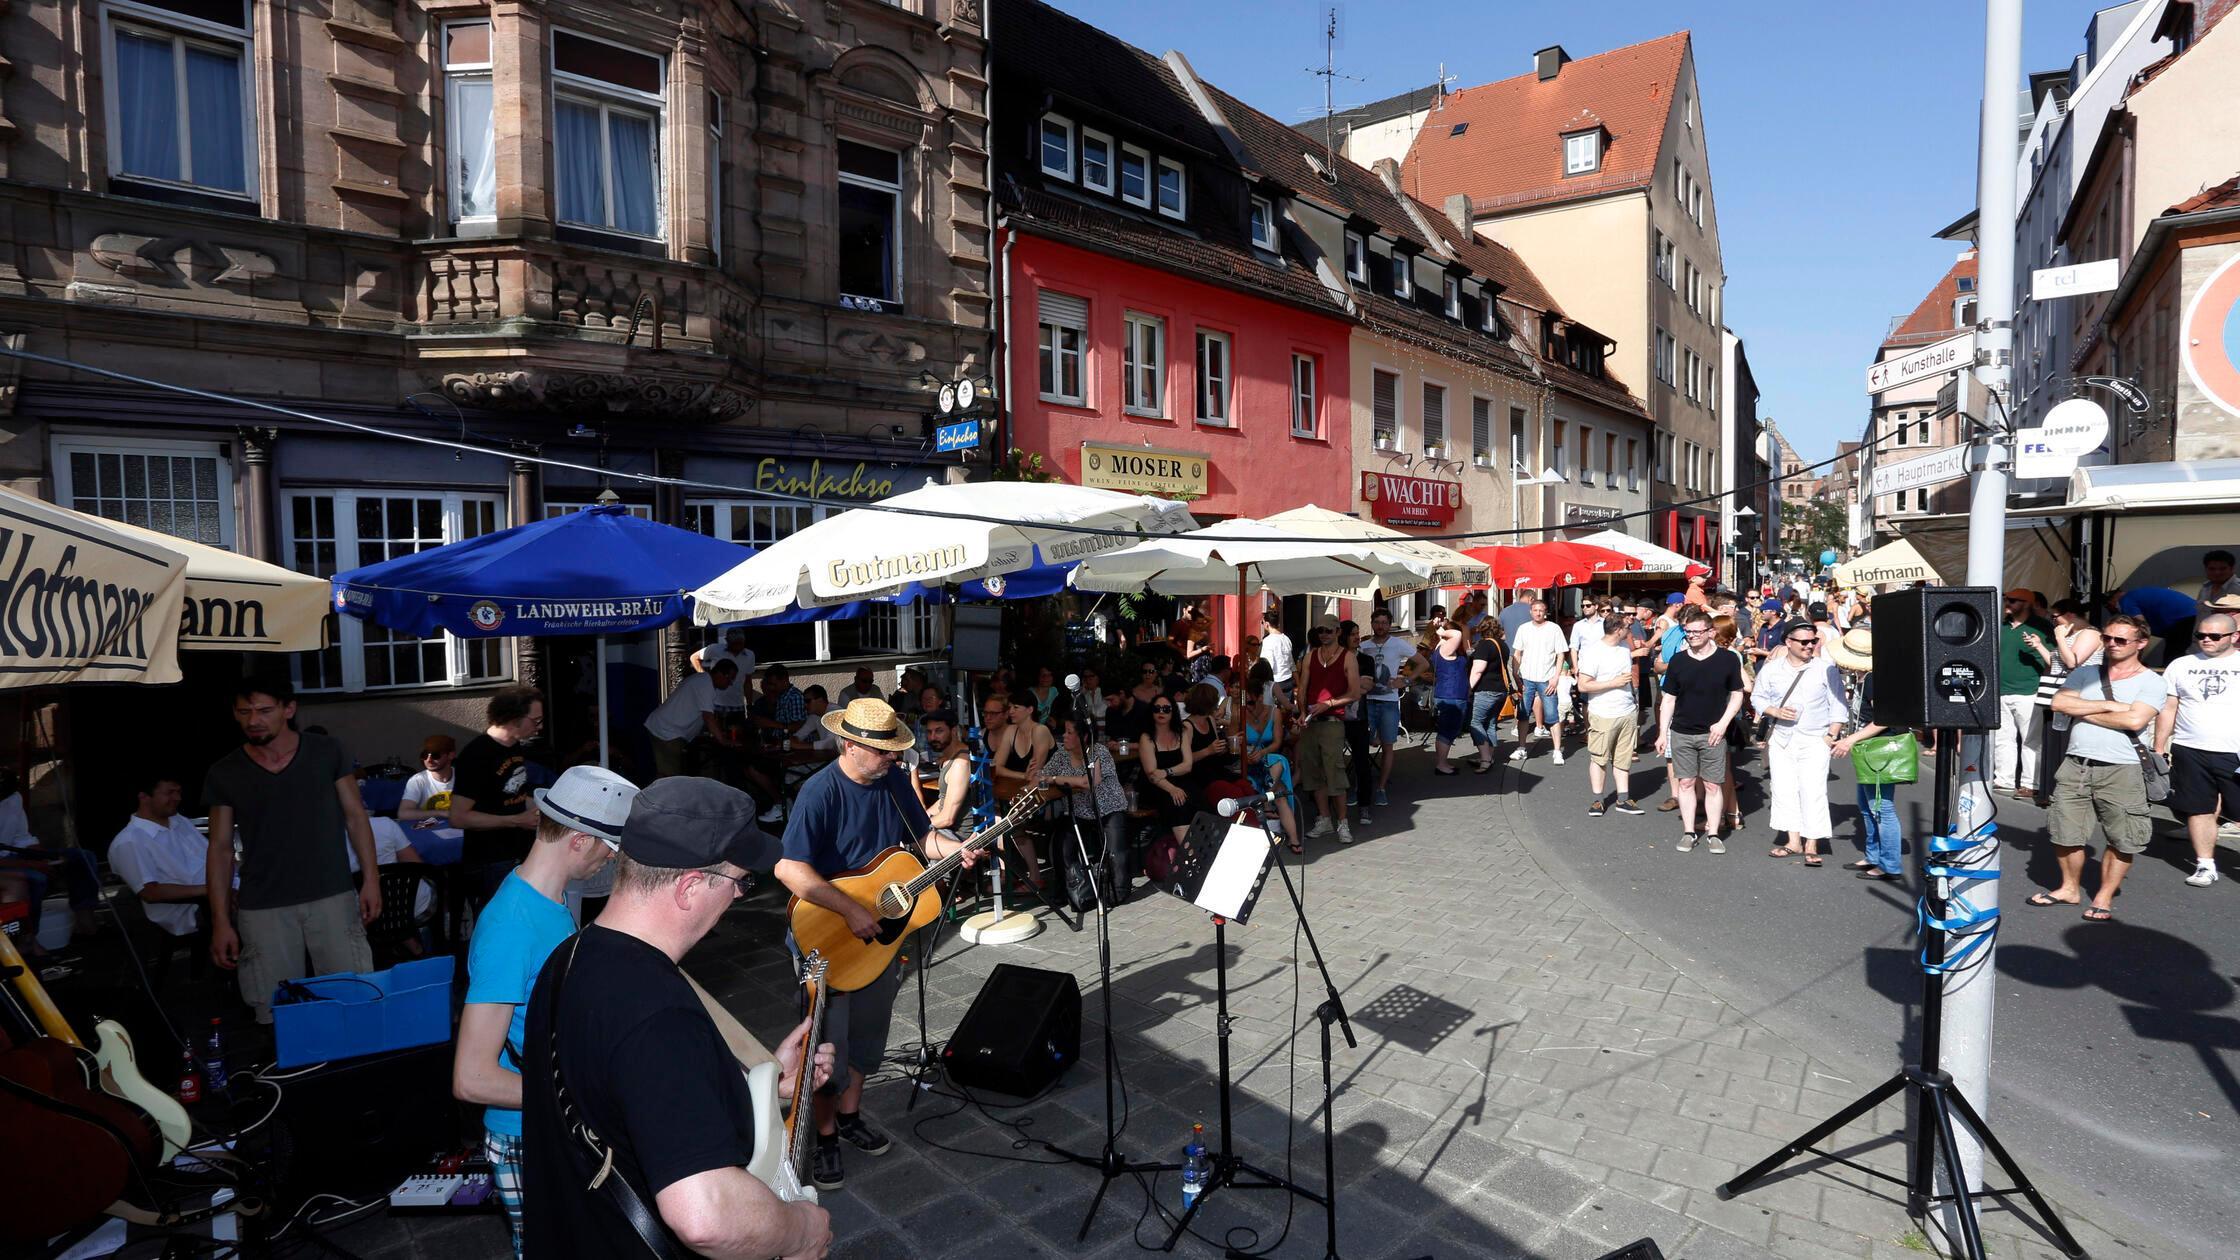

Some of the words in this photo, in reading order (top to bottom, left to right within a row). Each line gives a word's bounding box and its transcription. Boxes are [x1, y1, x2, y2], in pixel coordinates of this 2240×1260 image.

[1901, 348, 1956, 377] Kunsthalle
[939, 425, 978, 449] Einfachso
[756, 457, 893, 499] Einfachso
[1111, 455, 1183, 479] MOSER
[1898, 454, 1960, 484] Hauptmarkt
[1382, 477, 1446, 507] WACHT
[1401, 507, 1411, 515] AM
[1411, 508, 1429, 516] RHEIN
[828, 543, 967, 588] Gutmann
[1461, 567, 1487, 583] Hofmann
[1853, 564, 1925, 583] Hofmann
[516, 599, 663, 619] LANDWEHR-BRÄU
